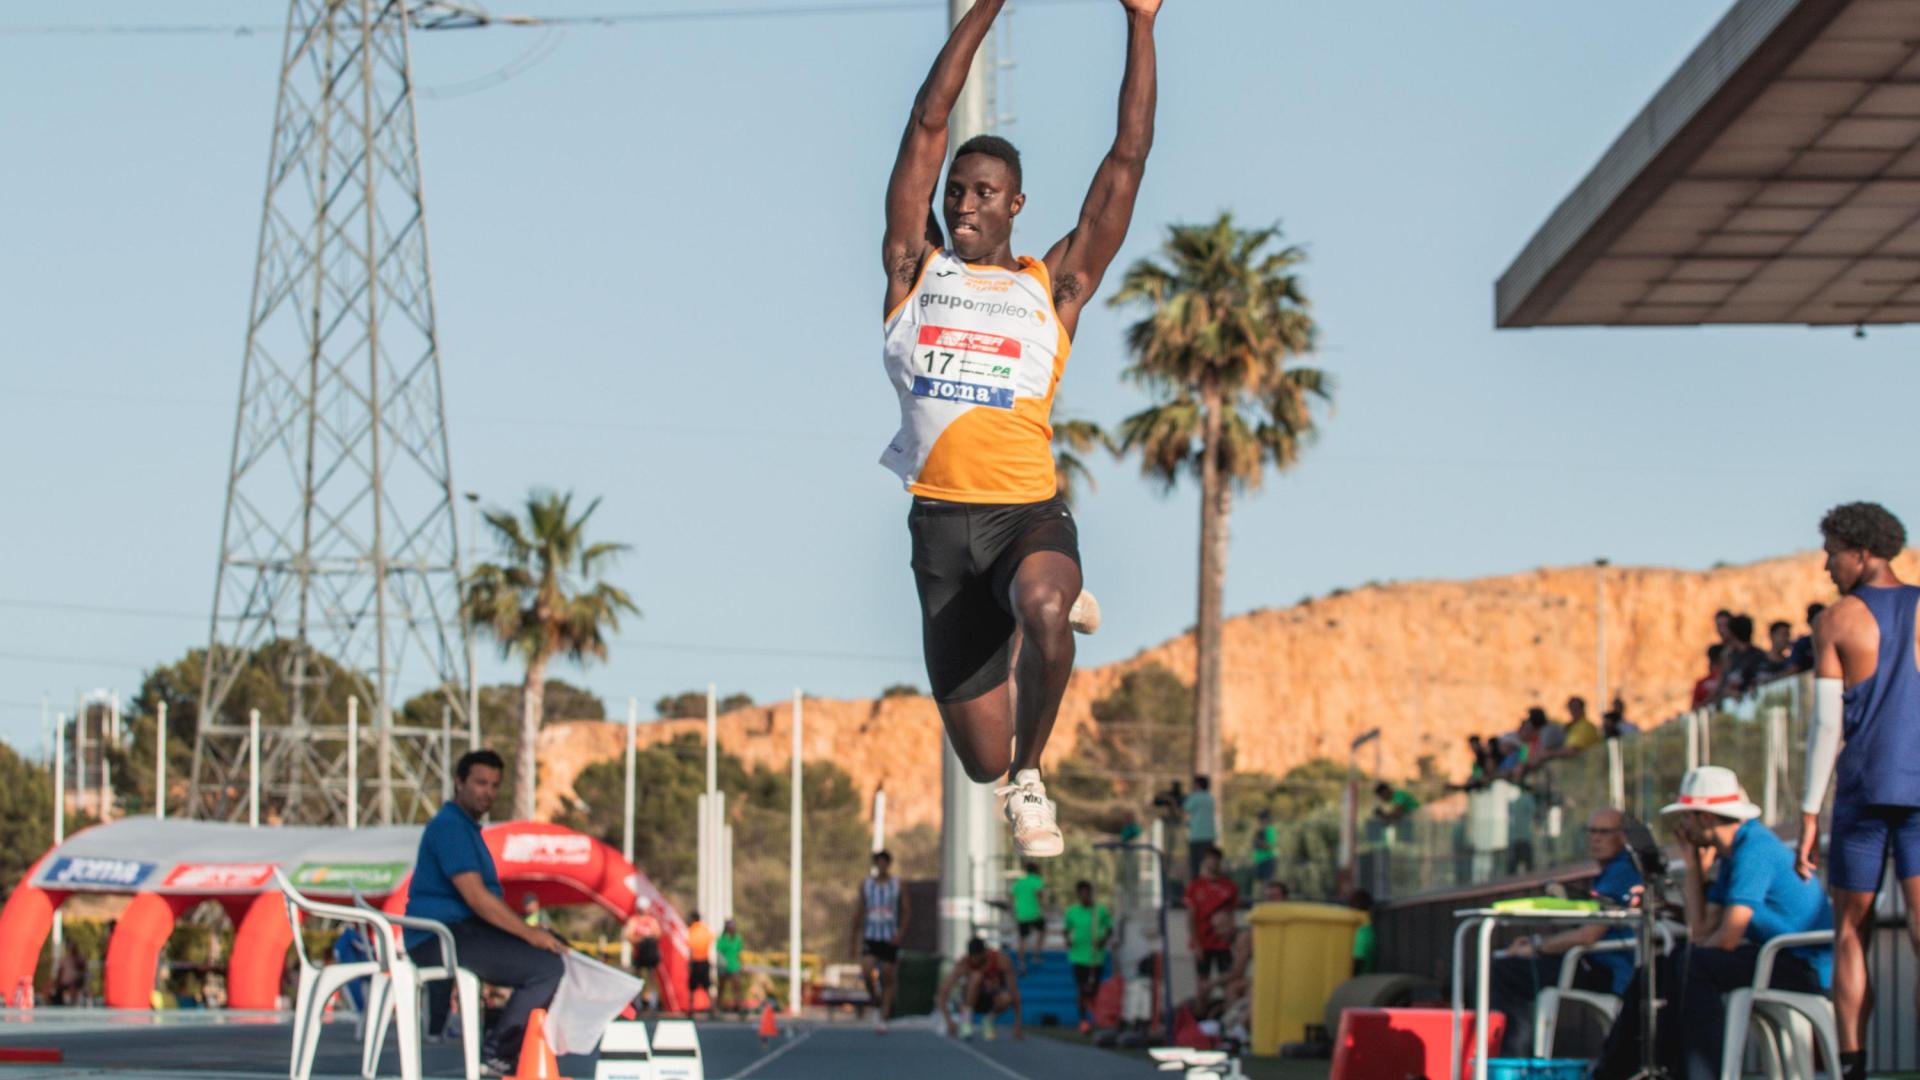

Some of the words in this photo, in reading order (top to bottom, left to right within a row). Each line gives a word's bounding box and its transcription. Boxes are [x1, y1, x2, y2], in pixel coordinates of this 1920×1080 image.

[920, 293, 1028, 317] grupompleo
[924, 350, 954, 375] 17
[928, 381, 991, 402] Joma
